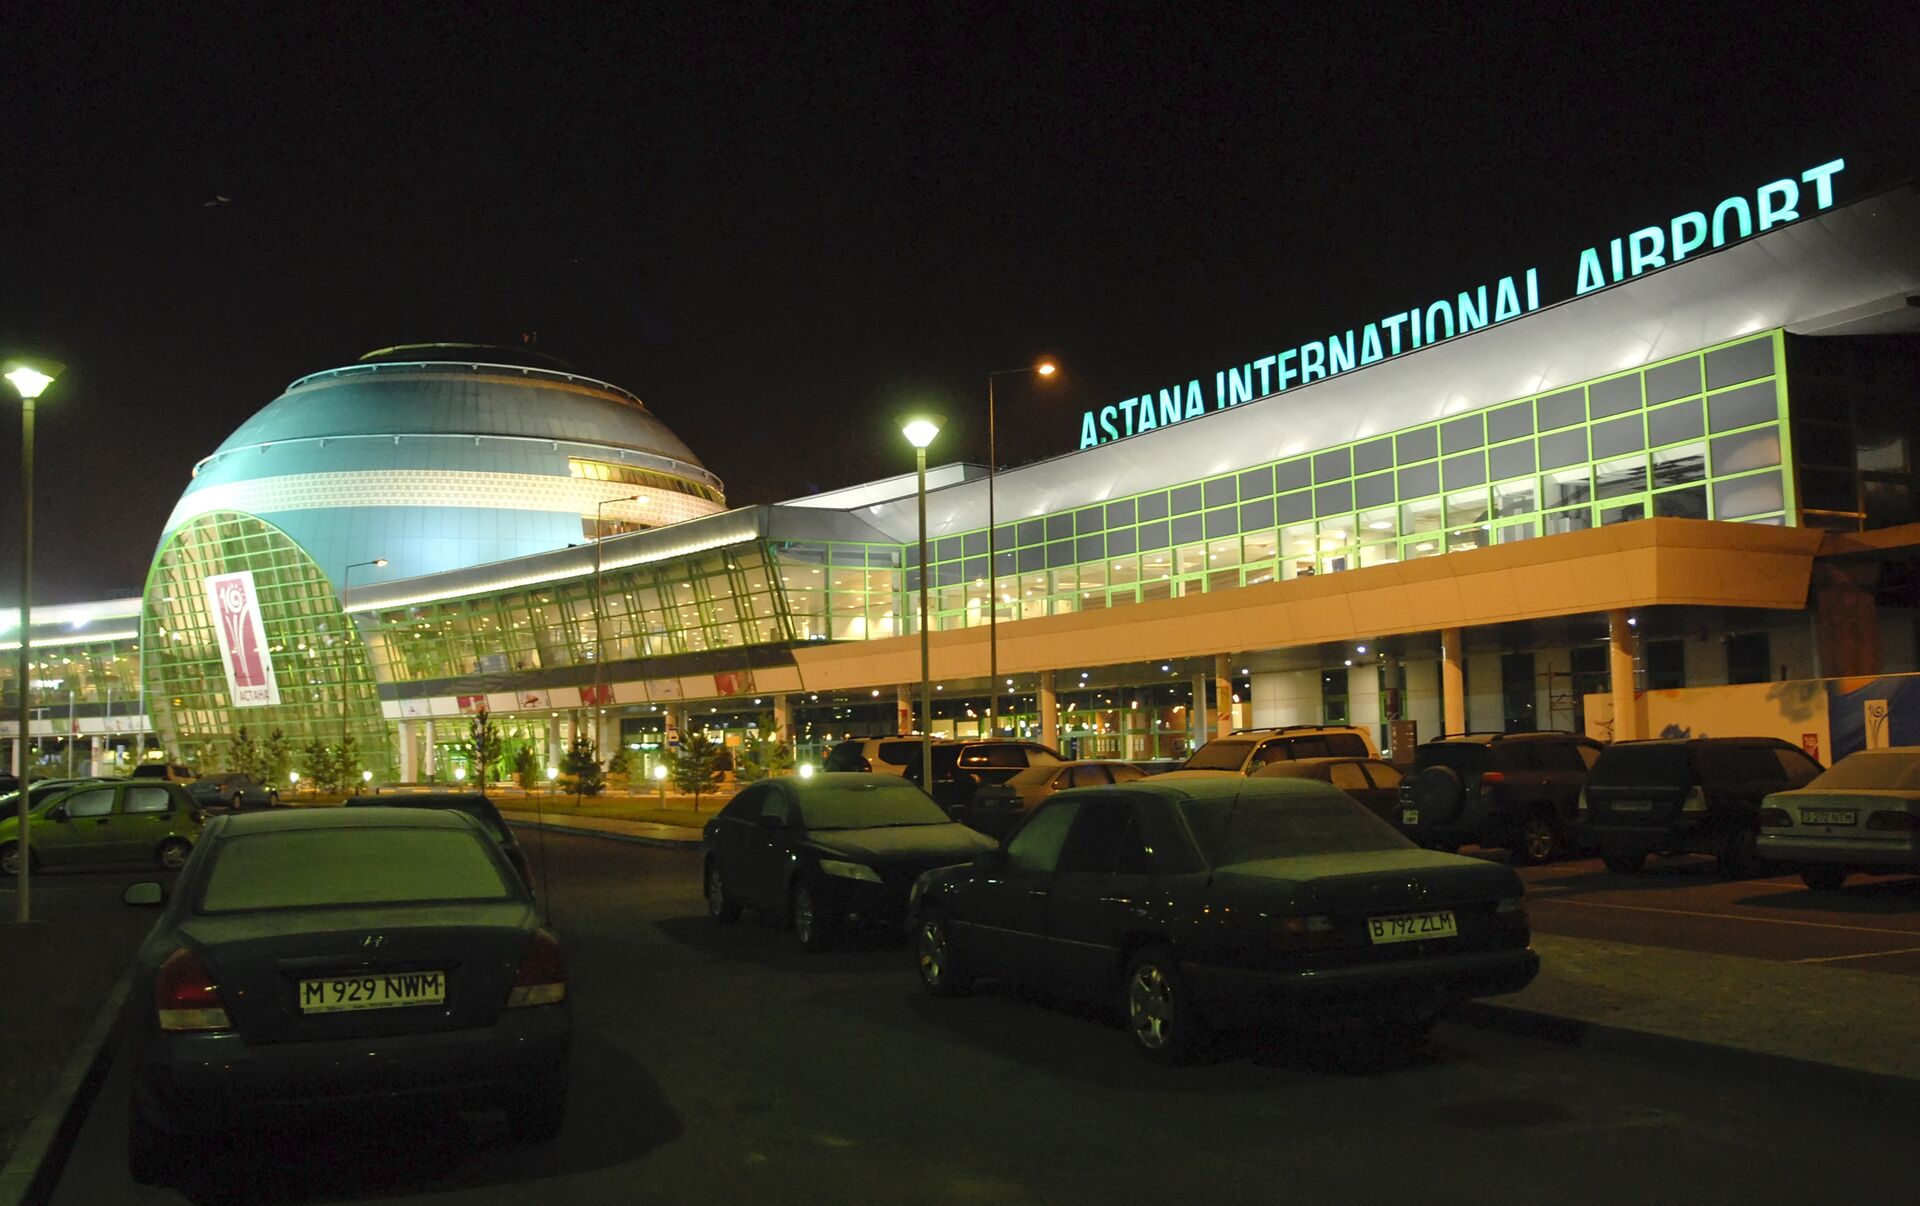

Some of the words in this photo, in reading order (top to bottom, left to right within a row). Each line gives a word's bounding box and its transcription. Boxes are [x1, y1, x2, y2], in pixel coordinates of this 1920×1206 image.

[1080, 379, 1205, 450] ASTANA
[1216, 267, 1540, 410] INTERNATIONAL
[1576, 158, 1845, 295] AIRPORT
[1373, 919, 1384, 937] B
[1387, 916, 1416, 935] 792
[1418, 913, 1452, 932] ZLM
[306, 981, 324, 1005] M
[332, 978, 377, 1003] 929
[385, 974, 439, 999] NWM
